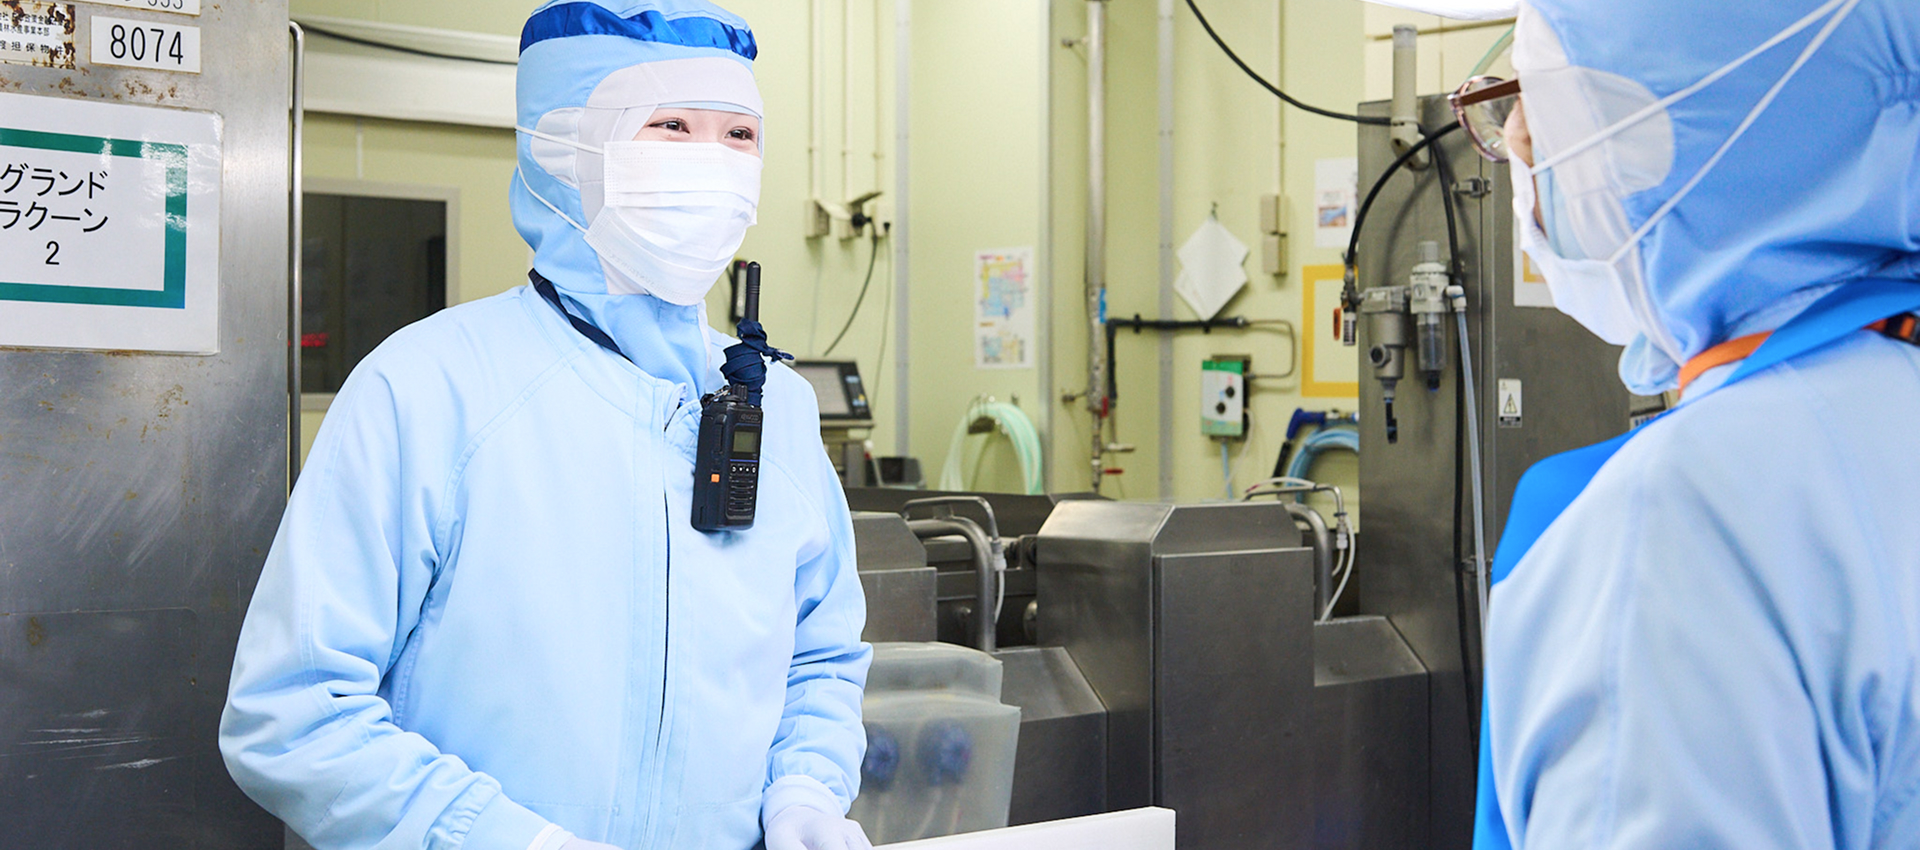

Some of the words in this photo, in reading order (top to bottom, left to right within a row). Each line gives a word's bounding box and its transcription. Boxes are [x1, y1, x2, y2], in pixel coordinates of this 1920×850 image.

[110, 24, 184, 65] 8074
[0, 162, 108, 199] グランド
[0, 201, 108, 232] ラクーン
[45, 240, 60, 265] 2
